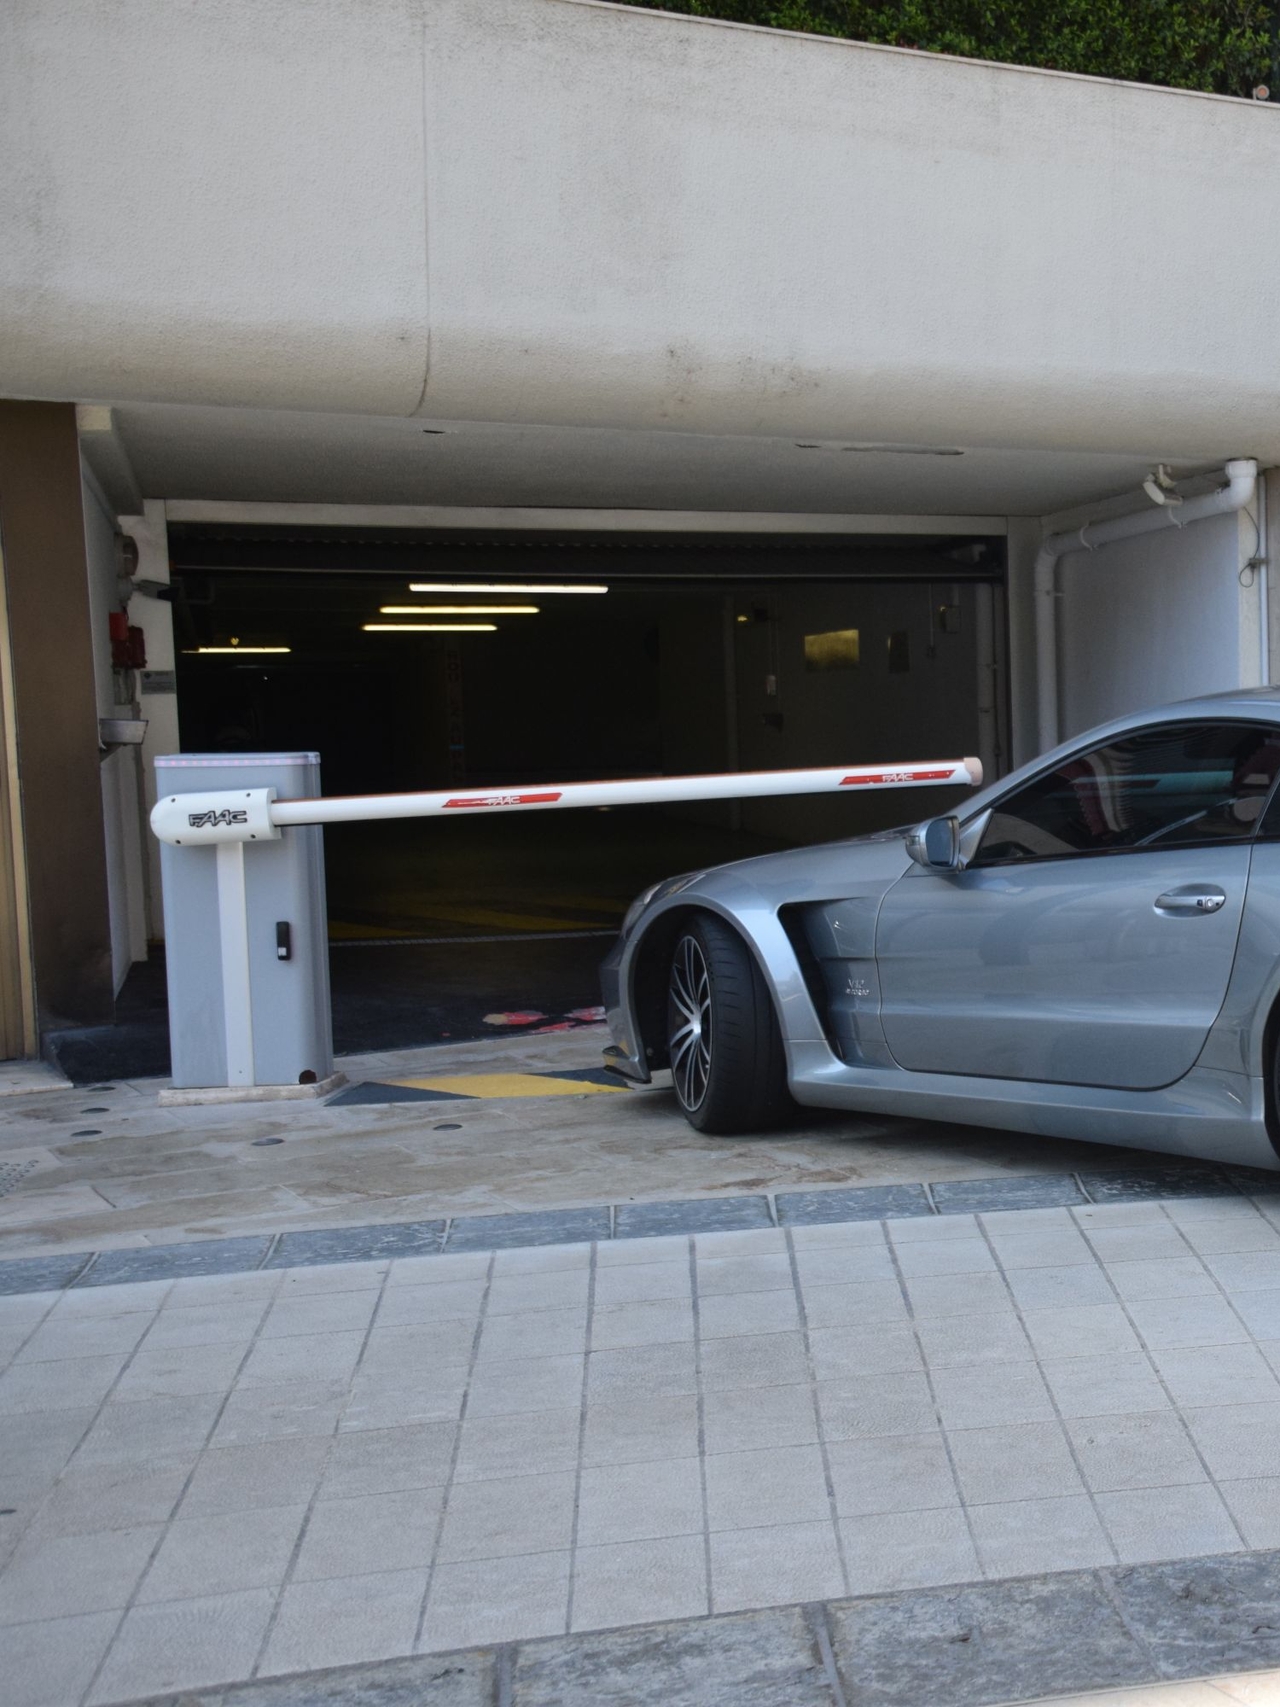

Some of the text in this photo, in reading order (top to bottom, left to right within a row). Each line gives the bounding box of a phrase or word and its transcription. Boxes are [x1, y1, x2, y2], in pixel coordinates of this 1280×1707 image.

[882, 773, 914, 783] FAAC
[487, 795, 521, 806] FAAC
[188, 809, 248, 828] FAAC
